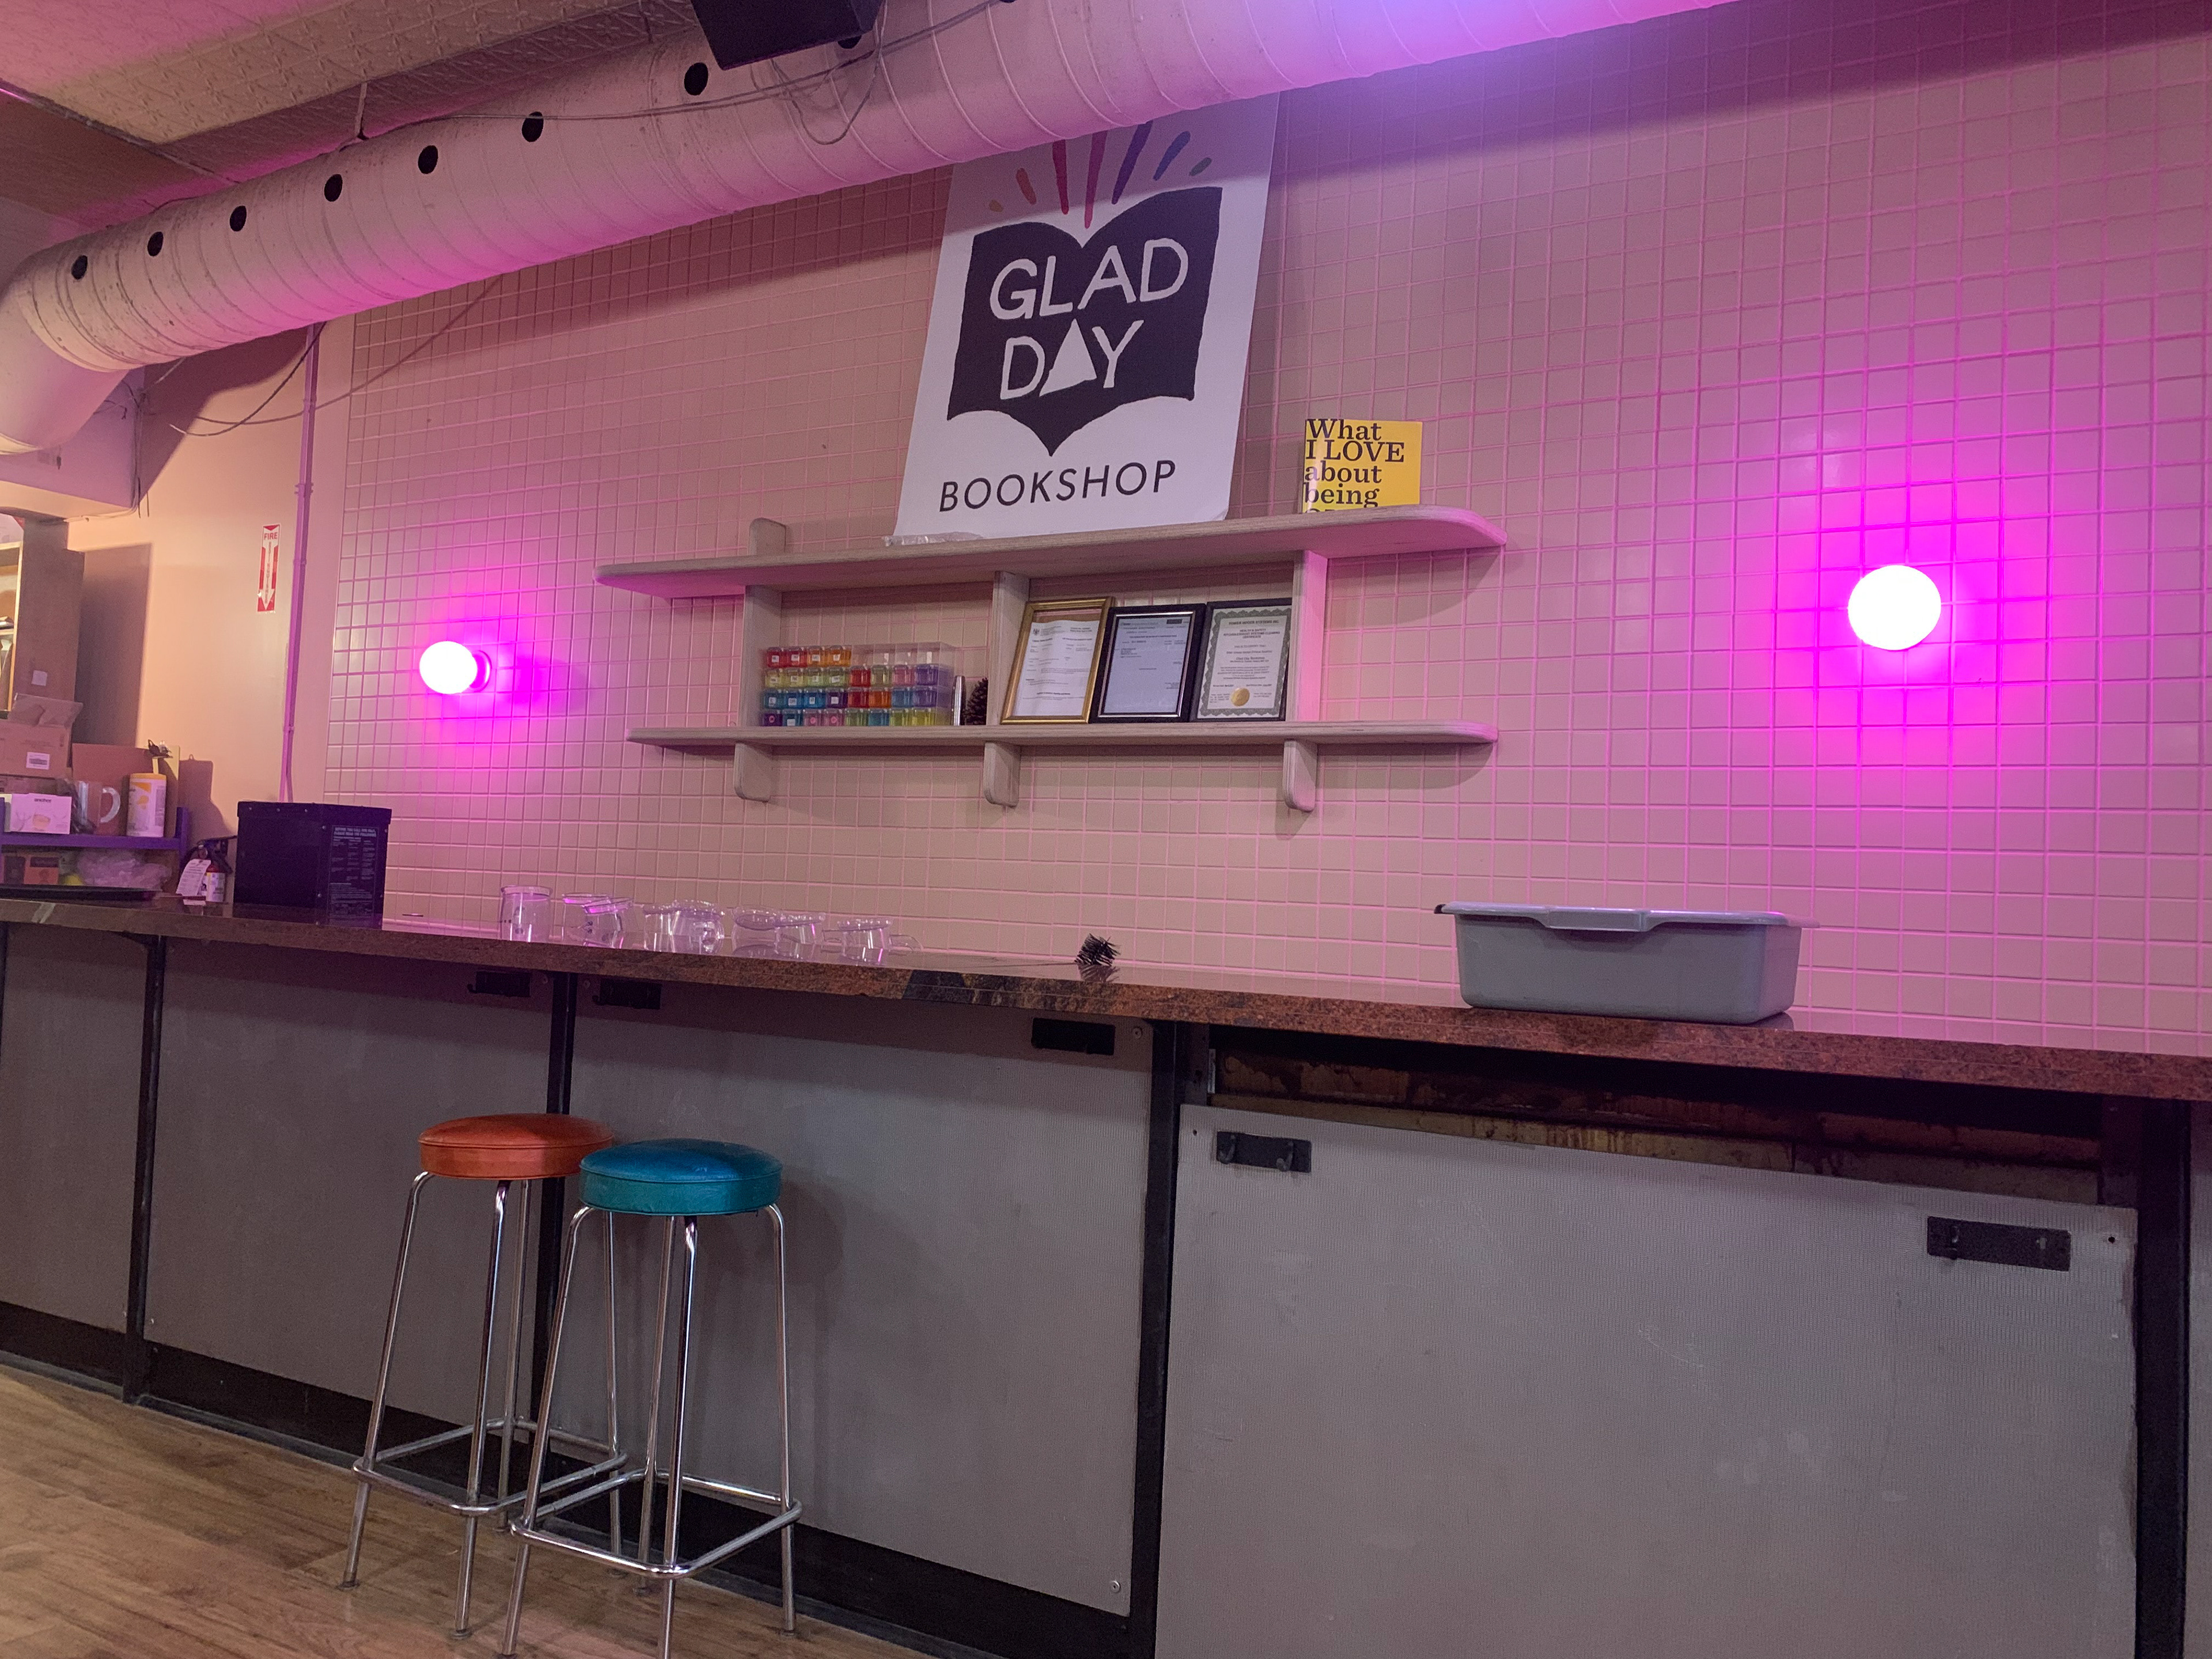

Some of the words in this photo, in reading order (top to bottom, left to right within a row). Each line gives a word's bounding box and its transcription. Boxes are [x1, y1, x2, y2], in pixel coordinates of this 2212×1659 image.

[990, 237, 1189, 320] GLAD
[999, 318, 1145, 400] DAY
[1306, 418, 1382, 441] What
[1306, 440, 1316, 459] I
[1324, 440, 1404, 462] LOVE
[1304, 461, 1382, 483] about
[938, 459, 1176, 513] BOOKSHOP
[1303, 482, 1380, 507] being
[264, 532, 278, 540] FIRE
